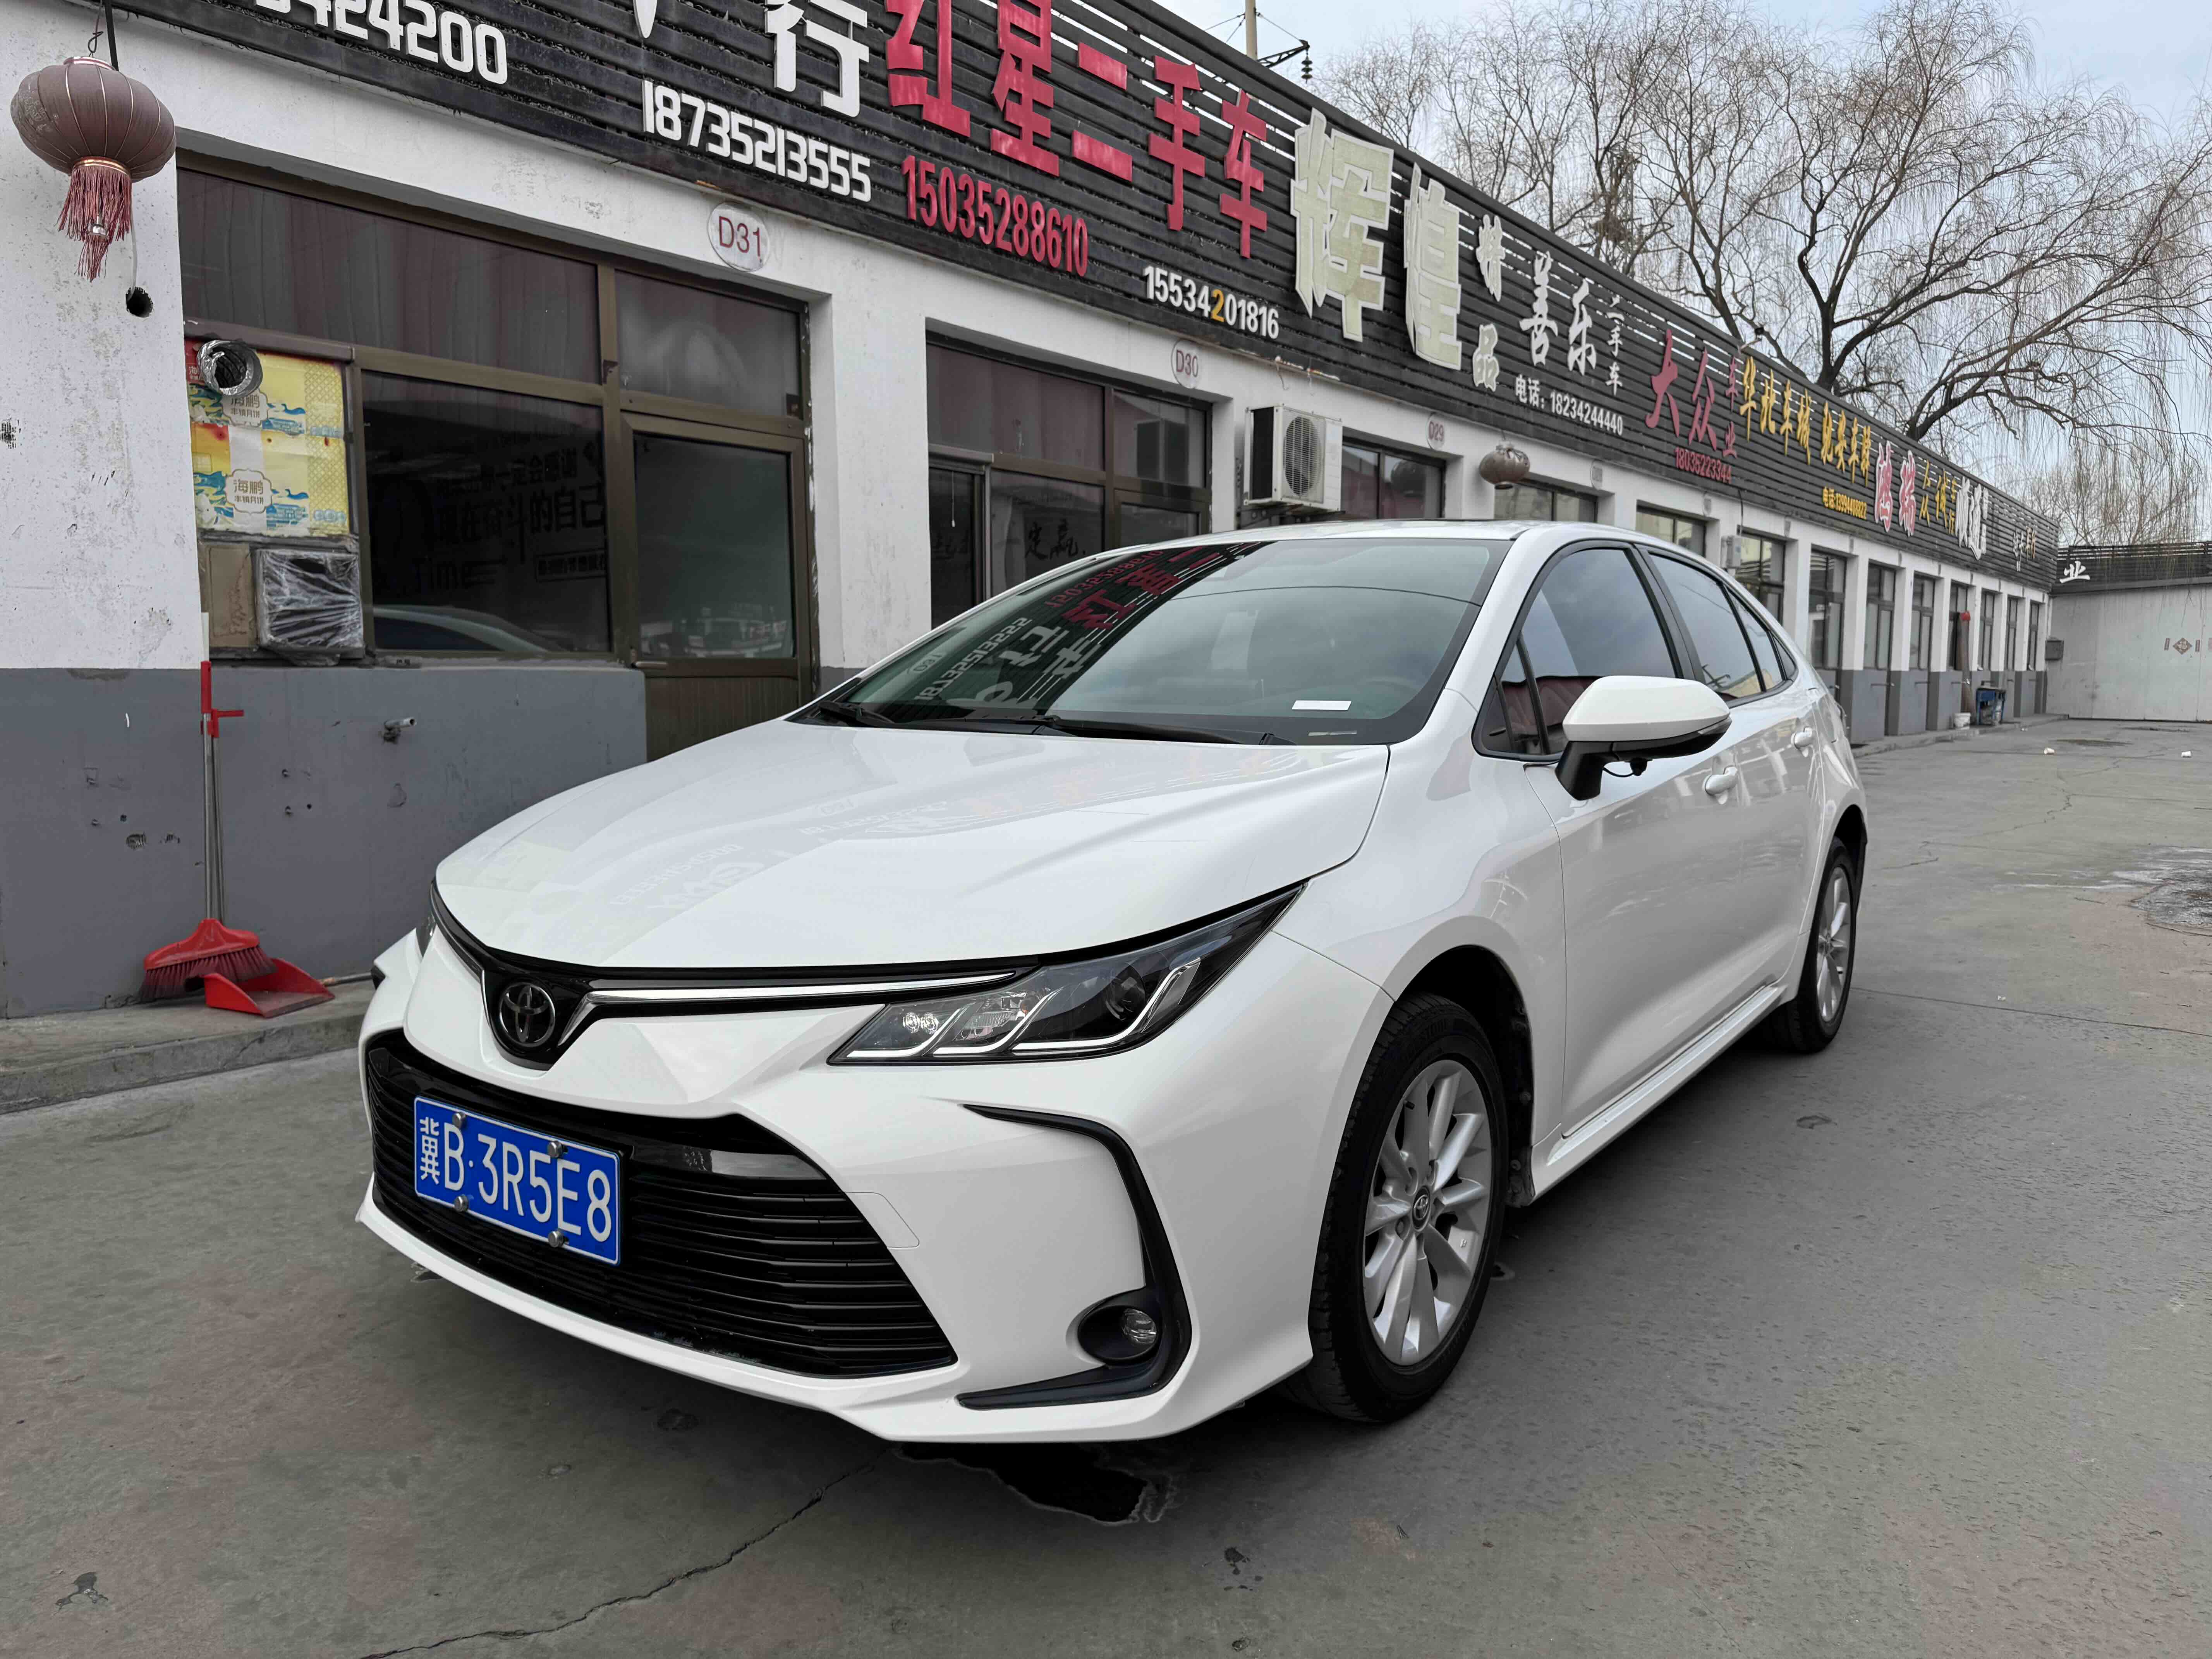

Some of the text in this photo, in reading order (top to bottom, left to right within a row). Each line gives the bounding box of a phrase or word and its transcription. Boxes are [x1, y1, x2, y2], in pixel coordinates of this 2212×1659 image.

[642, 79, 871, 203] 18735213555
[886, 0, 1267, 259] 红星二手车
[718, 216, 761, 258] D31
[901, 155, 1088, 276] 15035288610
[1144, 266, 1279, 339] 15534201816
[1176, 350, 1199, 378] D30
[1645, 329, 1717, 451] 大众
[233, 479, 264, 495] 海鹏
[2059, 561, 2090, 584] 业
[419, 1116, 611, 1242] 冀B·3R5E8
